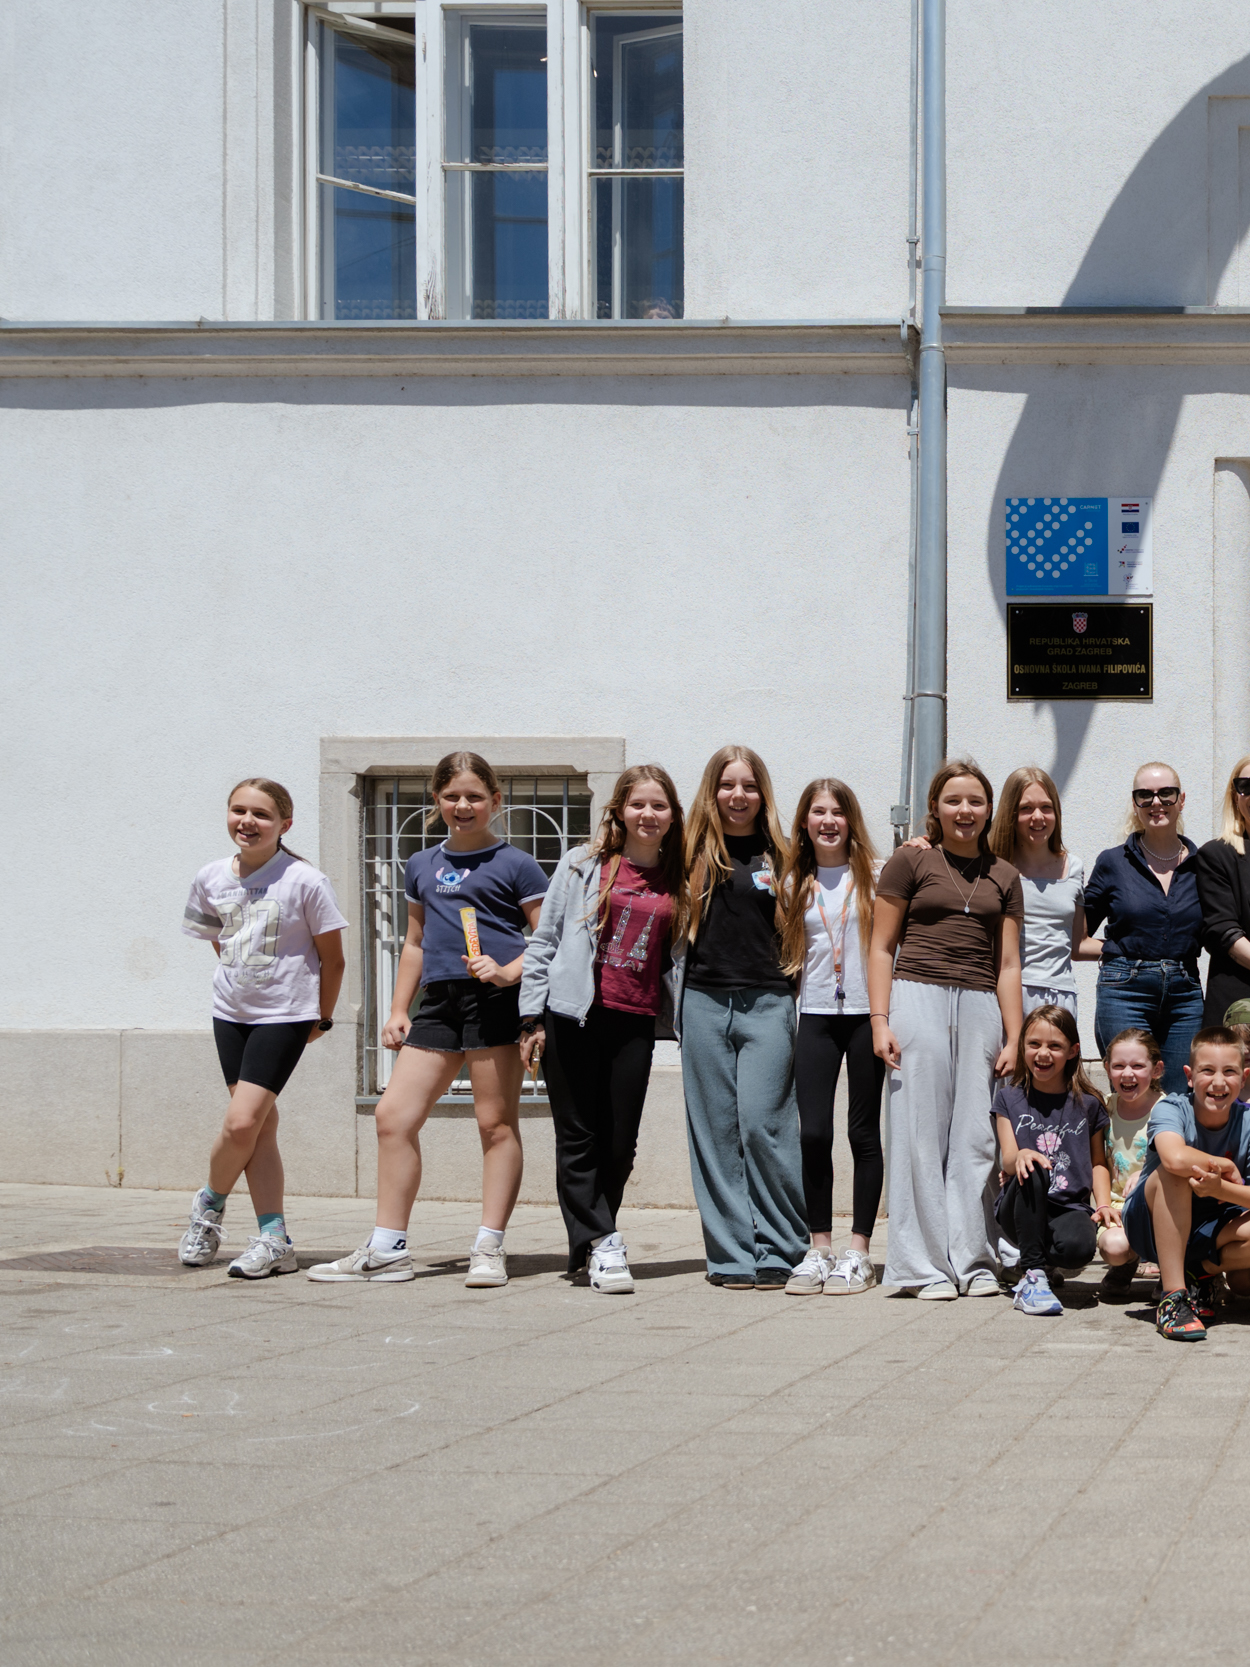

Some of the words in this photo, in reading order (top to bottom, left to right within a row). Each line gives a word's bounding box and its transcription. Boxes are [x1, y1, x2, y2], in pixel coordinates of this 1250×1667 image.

[1014, 664, 1050, 674] OSNOVNA
[1052, 662, 1076, 674] ŠKOLA
[1078, 664, 1101, 674] IVANA
[1103, 662, 1146, 674] FILIPOVIĆA
[1062, 682, 1098, 690] ZAGREB
[435, 884, 462, 894] STITCH
[468, 922, 480, 957] CEDEVITA
[1016, 1114, 1088, 1140] Peaceful
